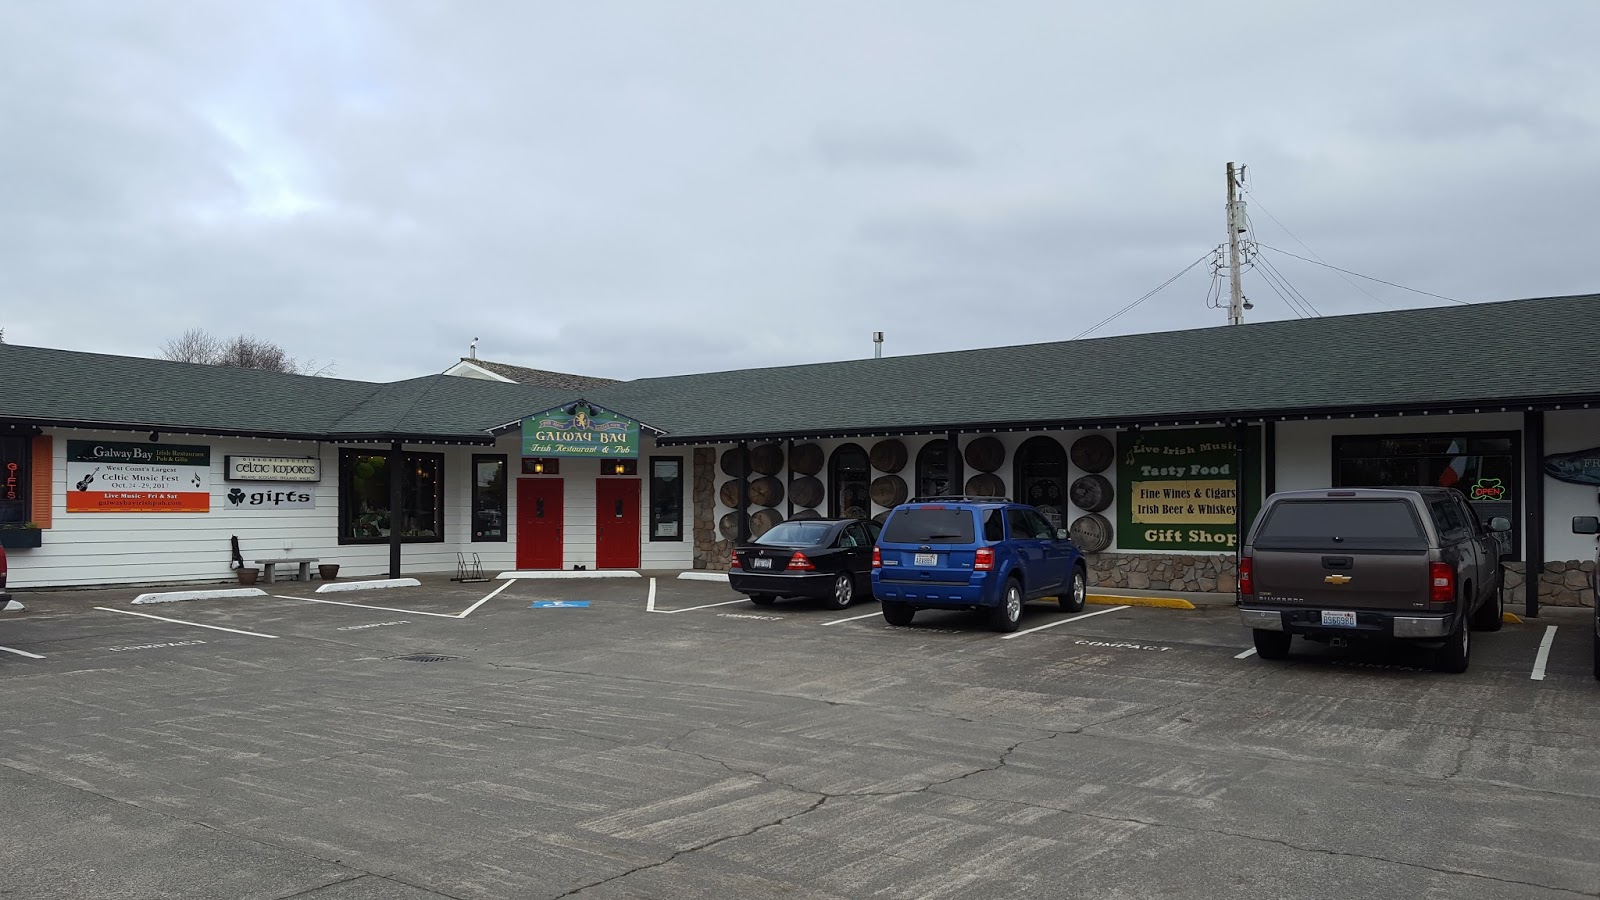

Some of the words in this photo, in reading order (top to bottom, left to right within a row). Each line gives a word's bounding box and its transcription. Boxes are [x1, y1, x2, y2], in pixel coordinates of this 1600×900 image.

[536, 431, 592, 442] GALWAY
[600, 432, 626, 443] BAY
[93, 446, 132, 460] Galway
[133, 448, 153, 461] Bay
[531, 444, 552, 452] Irish
[555, 445, 598, 453] Restaurant
[1133, 445, 1160, 454] Live
[1163, 446, 1195, 455] Irish
[1141, 465, 1186, 477] Tasty
[1190, 464, 1230, 475] Food
[7, 463, 17, 499] GIFTS
[250, 490, 310, 506] gifts
[1140, 489, 1160, 499] Fine
[1163, 489, 1191, 499] Wines
[1194, 488, 1202, 498] &
[1205, 488, 1236, 500] Cigars
[1475, 488, 1500, 496] OPEN
[1137, 504, 1159, 514] Irish
[1162, 504, 1183, 514] Beer
[1187, 504, 1194, 514] &
[1198, 504, 1237, 516] Whiskey
[1144, 530, 1182, 542] Gift
[1188, 530, 1237, 546] Shop
[1074, 640, 1173, 652] COMPACT
